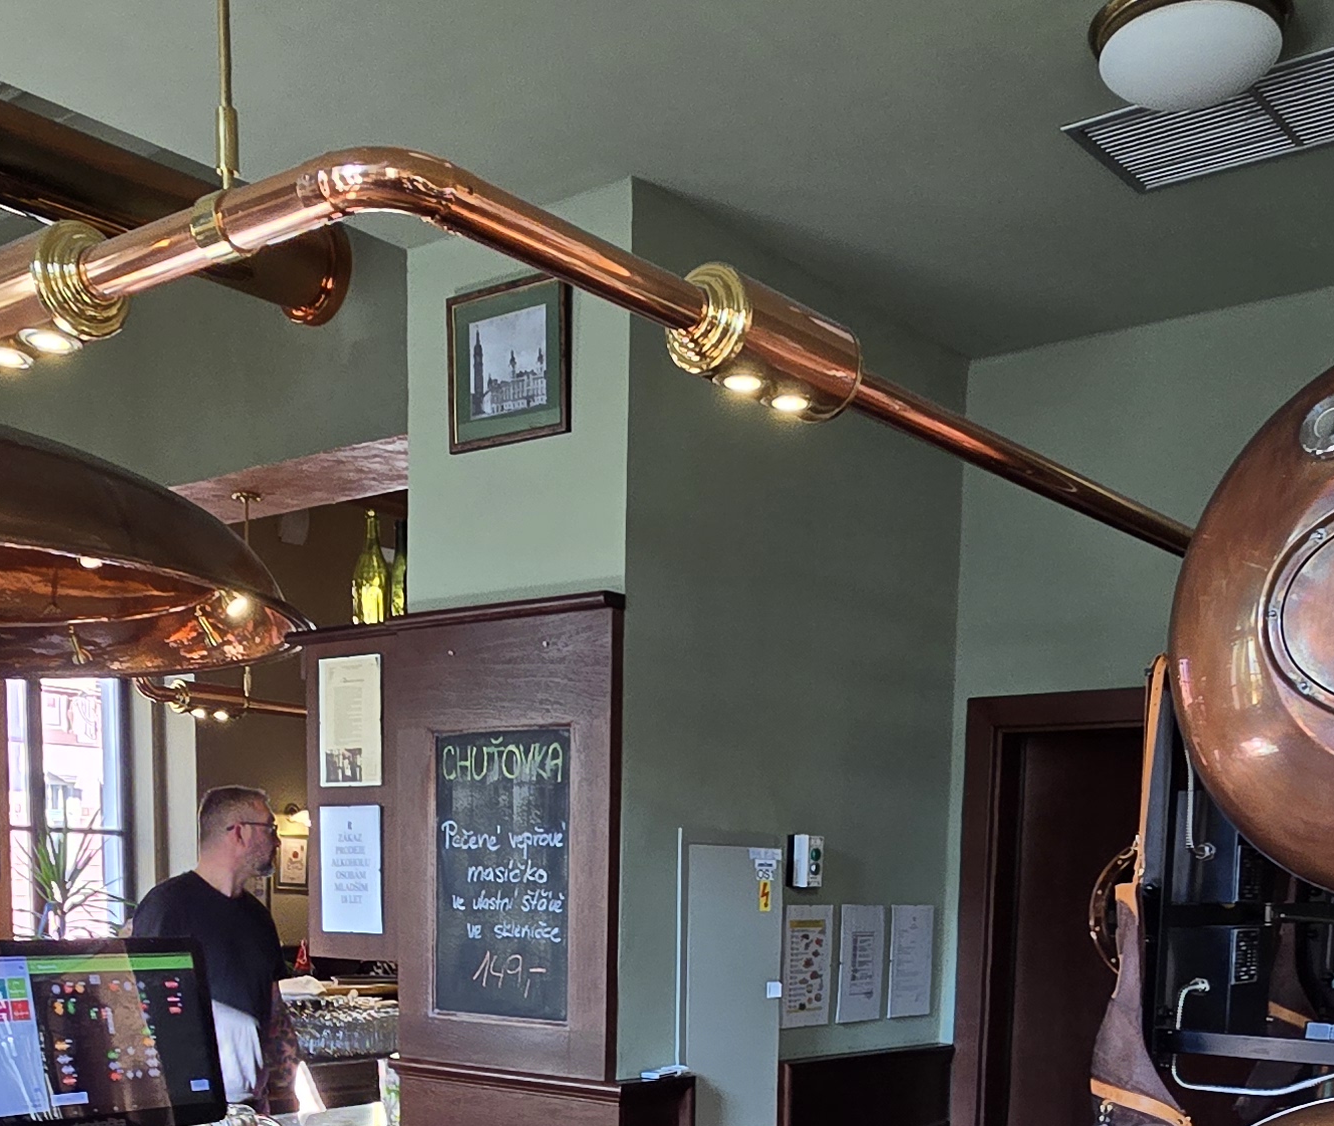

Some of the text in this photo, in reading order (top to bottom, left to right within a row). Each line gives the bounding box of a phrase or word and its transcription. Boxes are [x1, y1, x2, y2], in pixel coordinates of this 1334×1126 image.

[442, 735, 563, 783] CHUŤOVKA
[441, 820, 566, 859] Pečené vepřové
[467, 859, 548, 883] masíčko
[452, 887, 565, 913] ve vlastní šťávě
[467, 921, 562, 943] ve skleničce
[472, 950, 547, 999] 149,-
